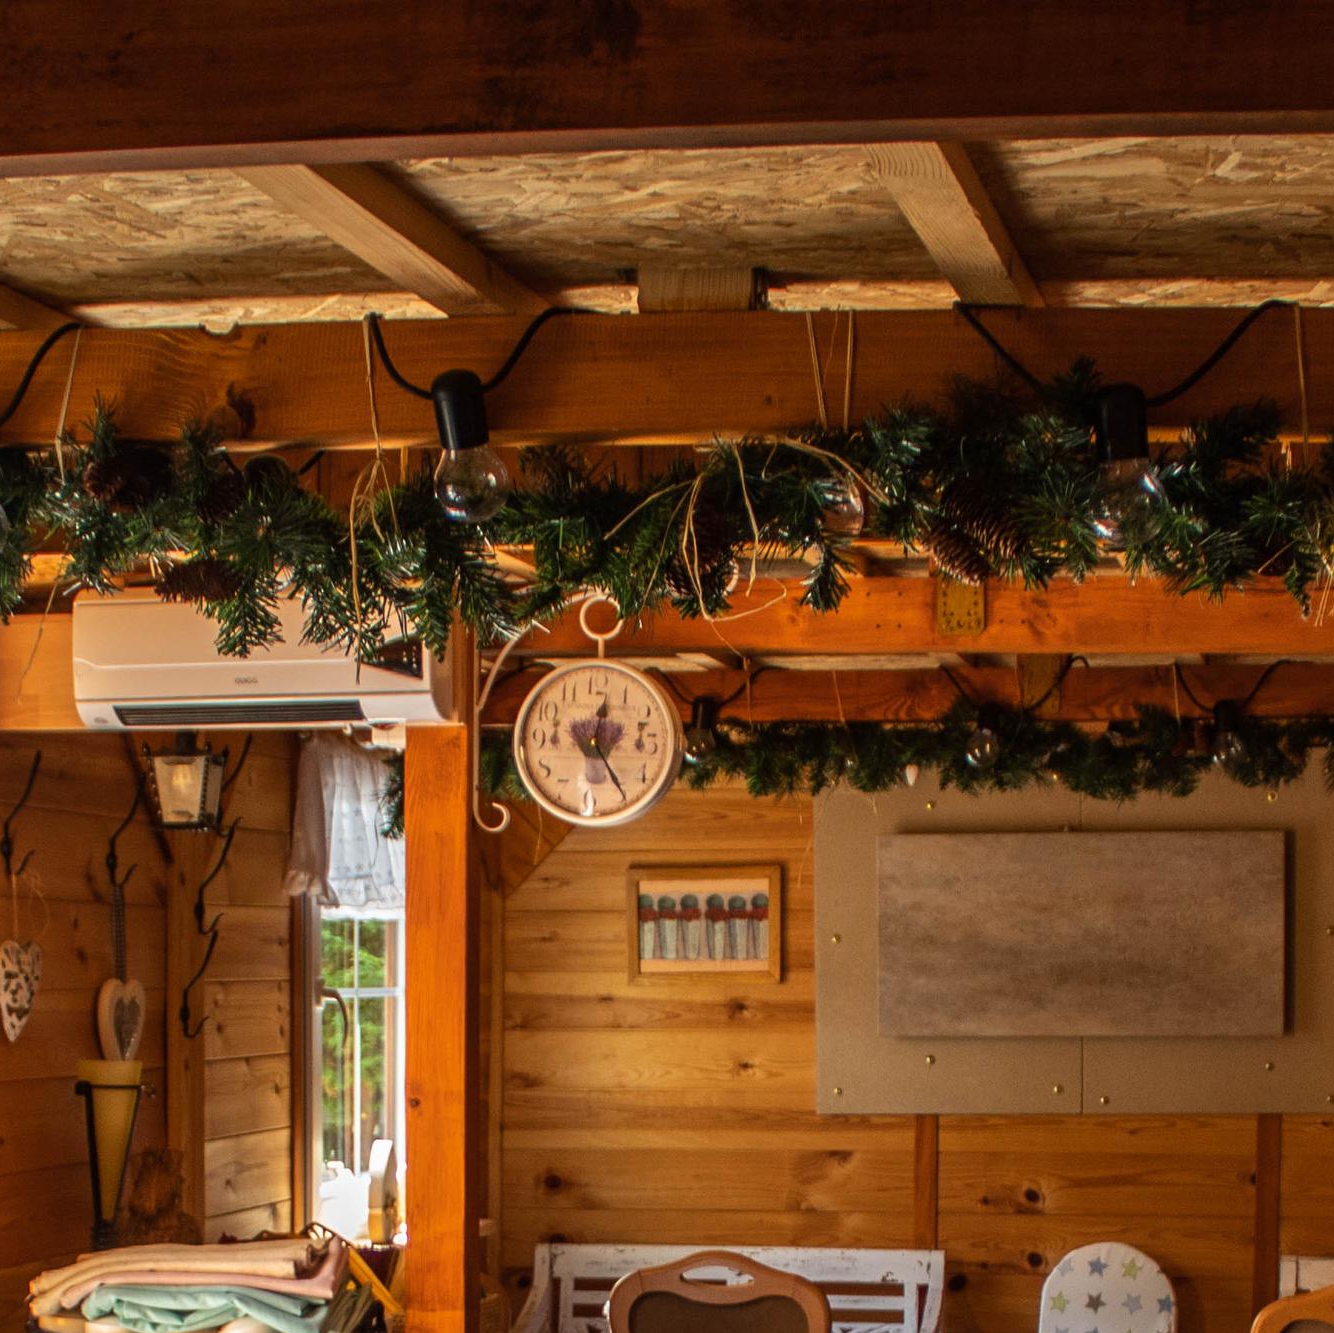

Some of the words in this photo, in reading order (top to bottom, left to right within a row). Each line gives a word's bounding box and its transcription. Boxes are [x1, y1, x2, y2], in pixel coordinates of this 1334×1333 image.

[562, 682, 577, 701] 11
[588, 674, 608, 695] 12
[622, 684, 628, 704] 1
[539, 701, 558, 721] 10
[532, 728, 546, 749] 9
[538, 759, 551, 778] 8
